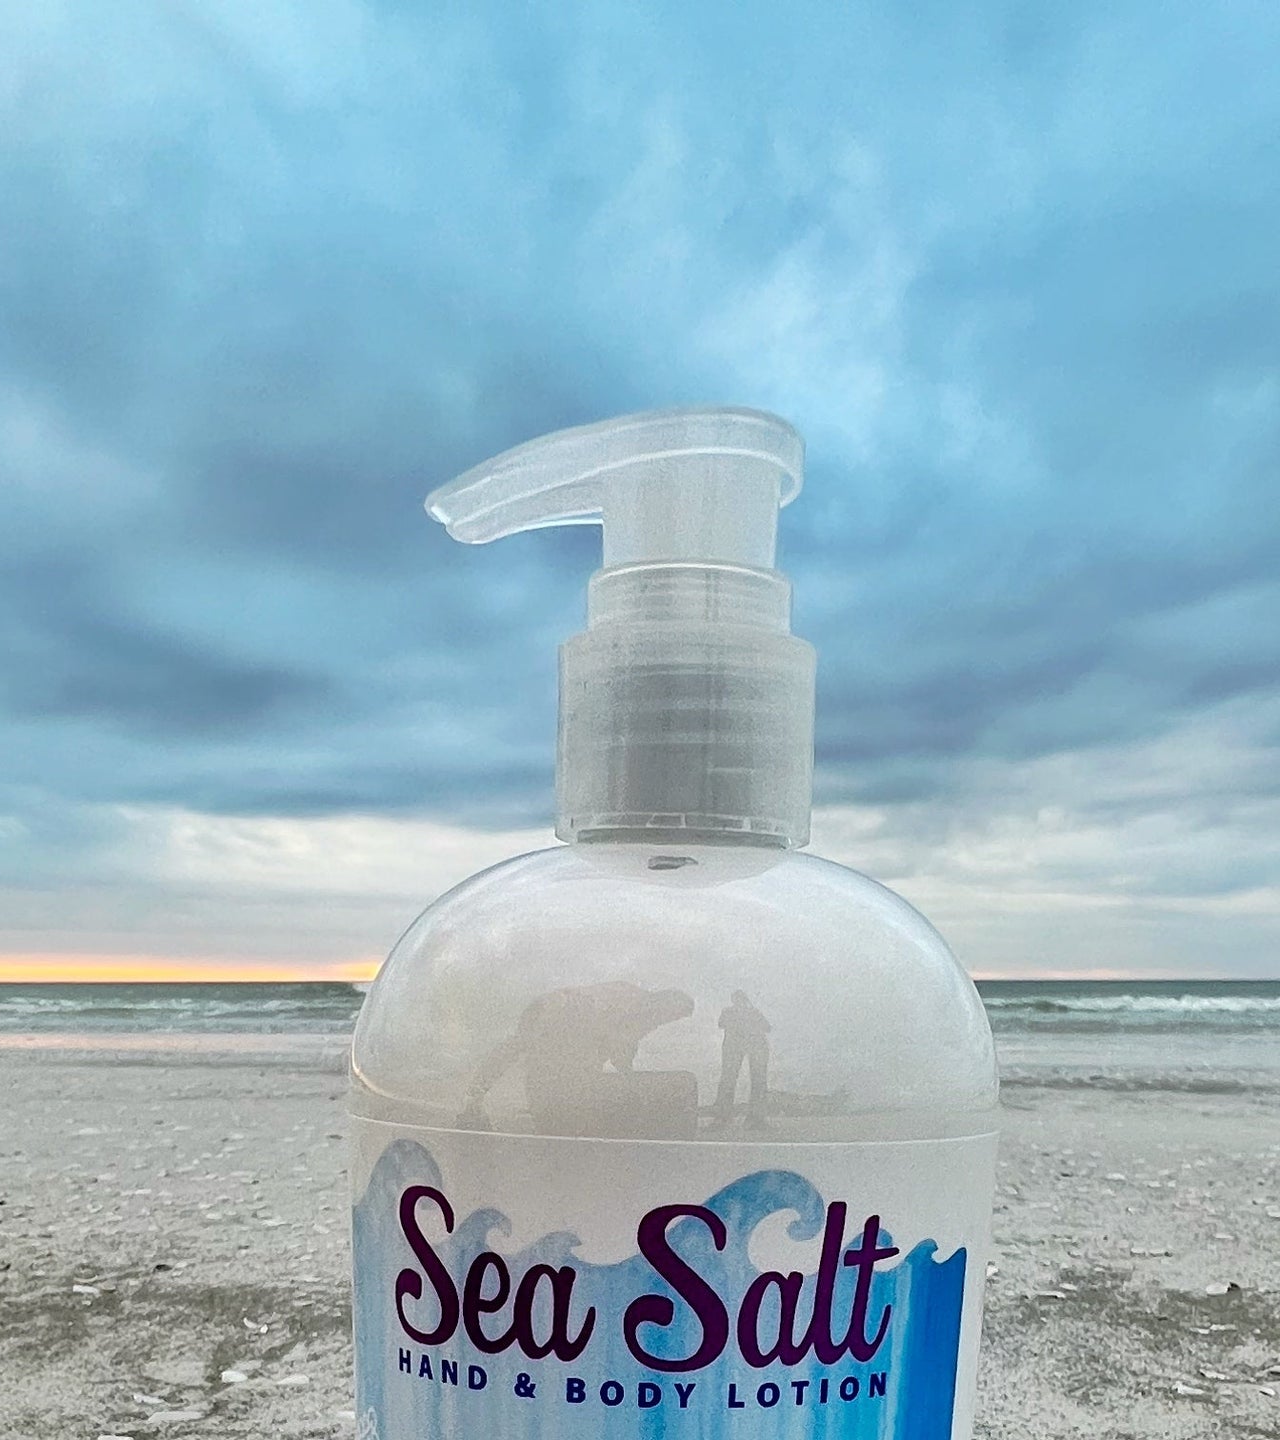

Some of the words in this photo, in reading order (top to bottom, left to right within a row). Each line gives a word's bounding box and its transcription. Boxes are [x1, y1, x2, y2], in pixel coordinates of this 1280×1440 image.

[395, 1185, 596, 1361] Sea
[623, 1201, 900, 1372] Salt
[399, 1347, 488, 1391] HAND
[514, 1372, 538, 1399] &
[566, 1377, 697, 1408] BODY
[728, 1371, 888, 1408] LOTION
